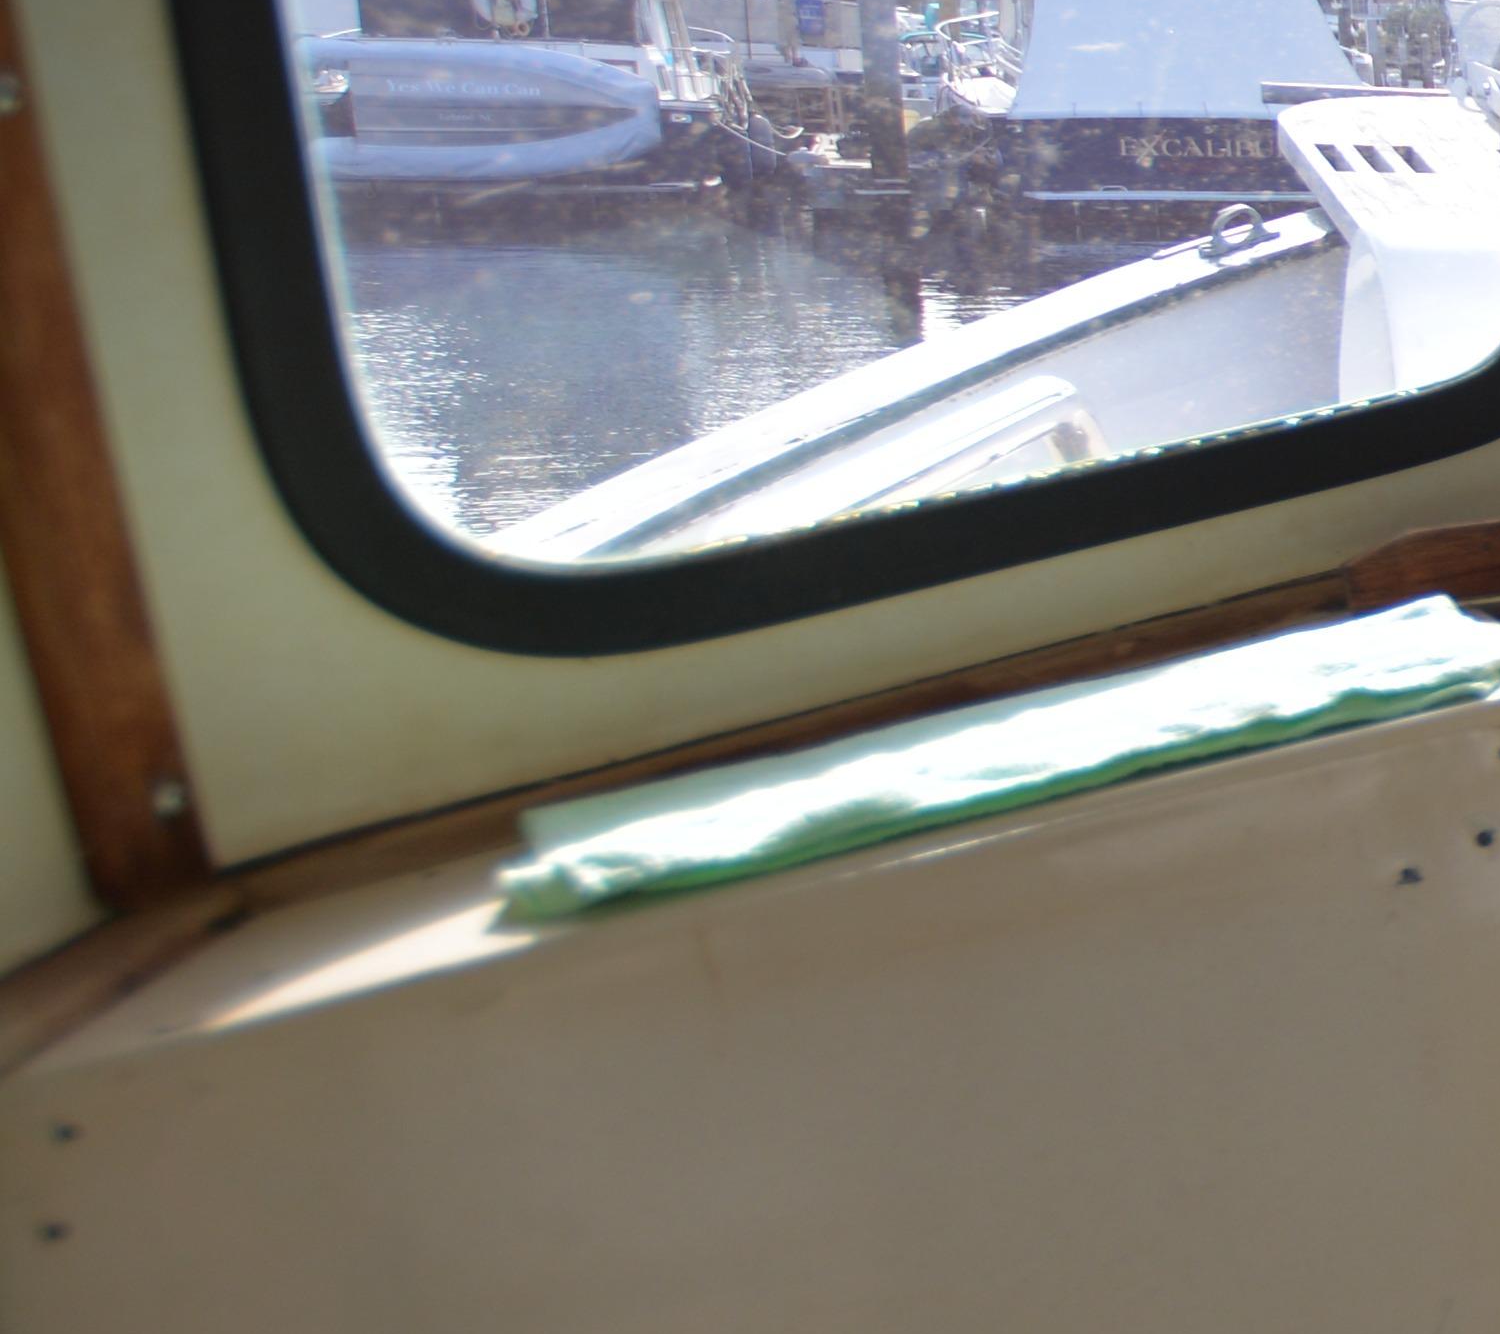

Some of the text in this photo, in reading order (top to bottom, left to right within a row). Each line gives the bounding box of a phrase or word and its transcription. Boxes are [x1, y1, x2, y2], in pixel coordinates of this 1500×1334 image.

[386, 78, 542, 97] Yes We Can Can
